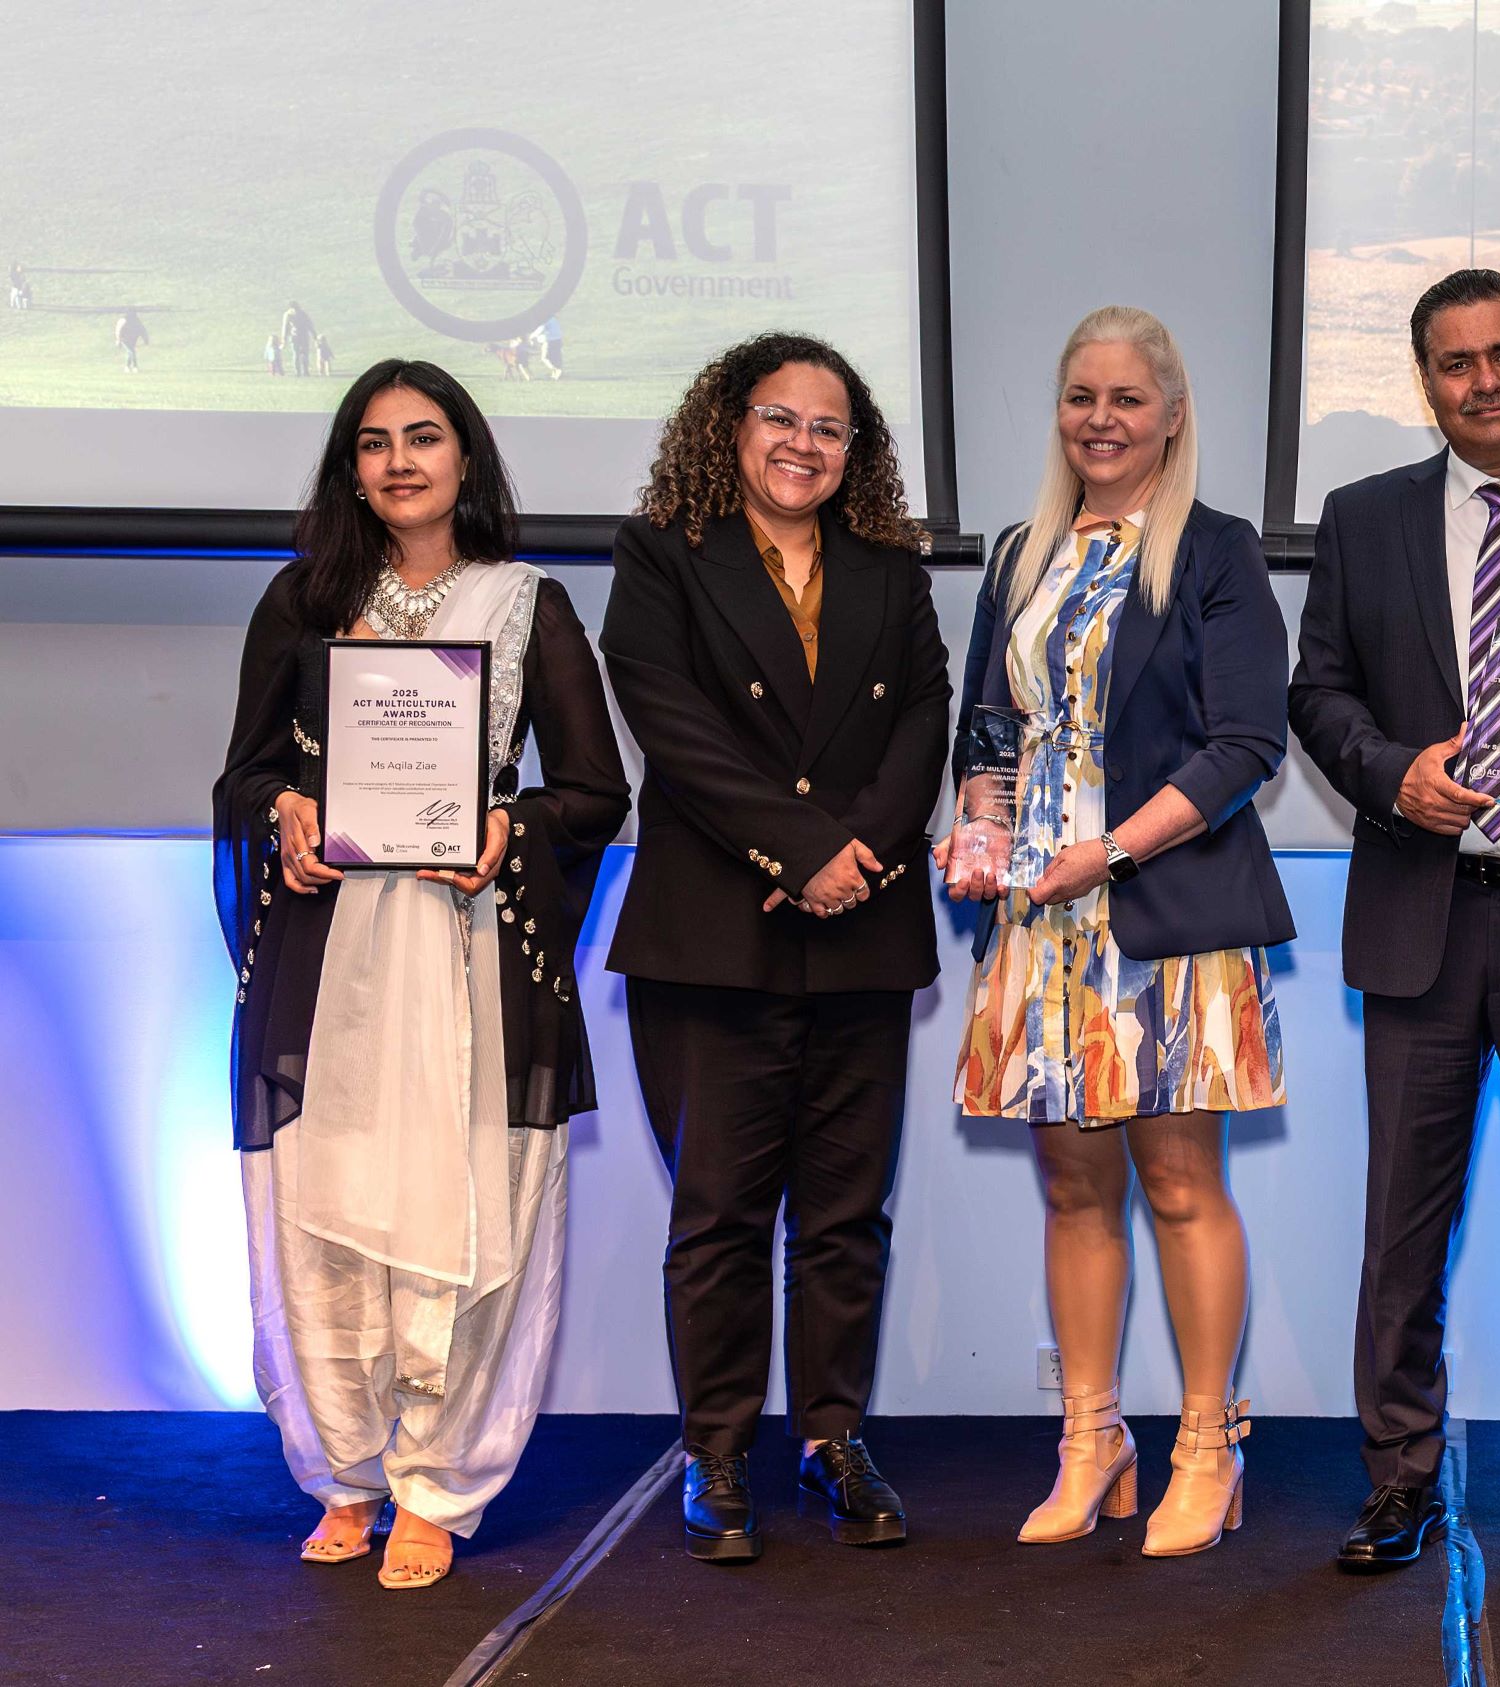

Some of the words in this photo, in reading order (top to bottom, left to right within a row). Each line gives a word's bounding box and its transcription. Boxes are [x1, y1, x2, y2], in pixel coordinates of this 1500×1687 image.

[612, 181, 792, 263] ACT
[612, 266, 794, 299] Government
[392, 689, 419, 697] 2025
[375, 700, 457, 708] MULTICULTURAL
[370, 761, 385, 770] Ms
[387, 761, 413, 771] Aqila
[415, 761, 437, 770] Ziae
